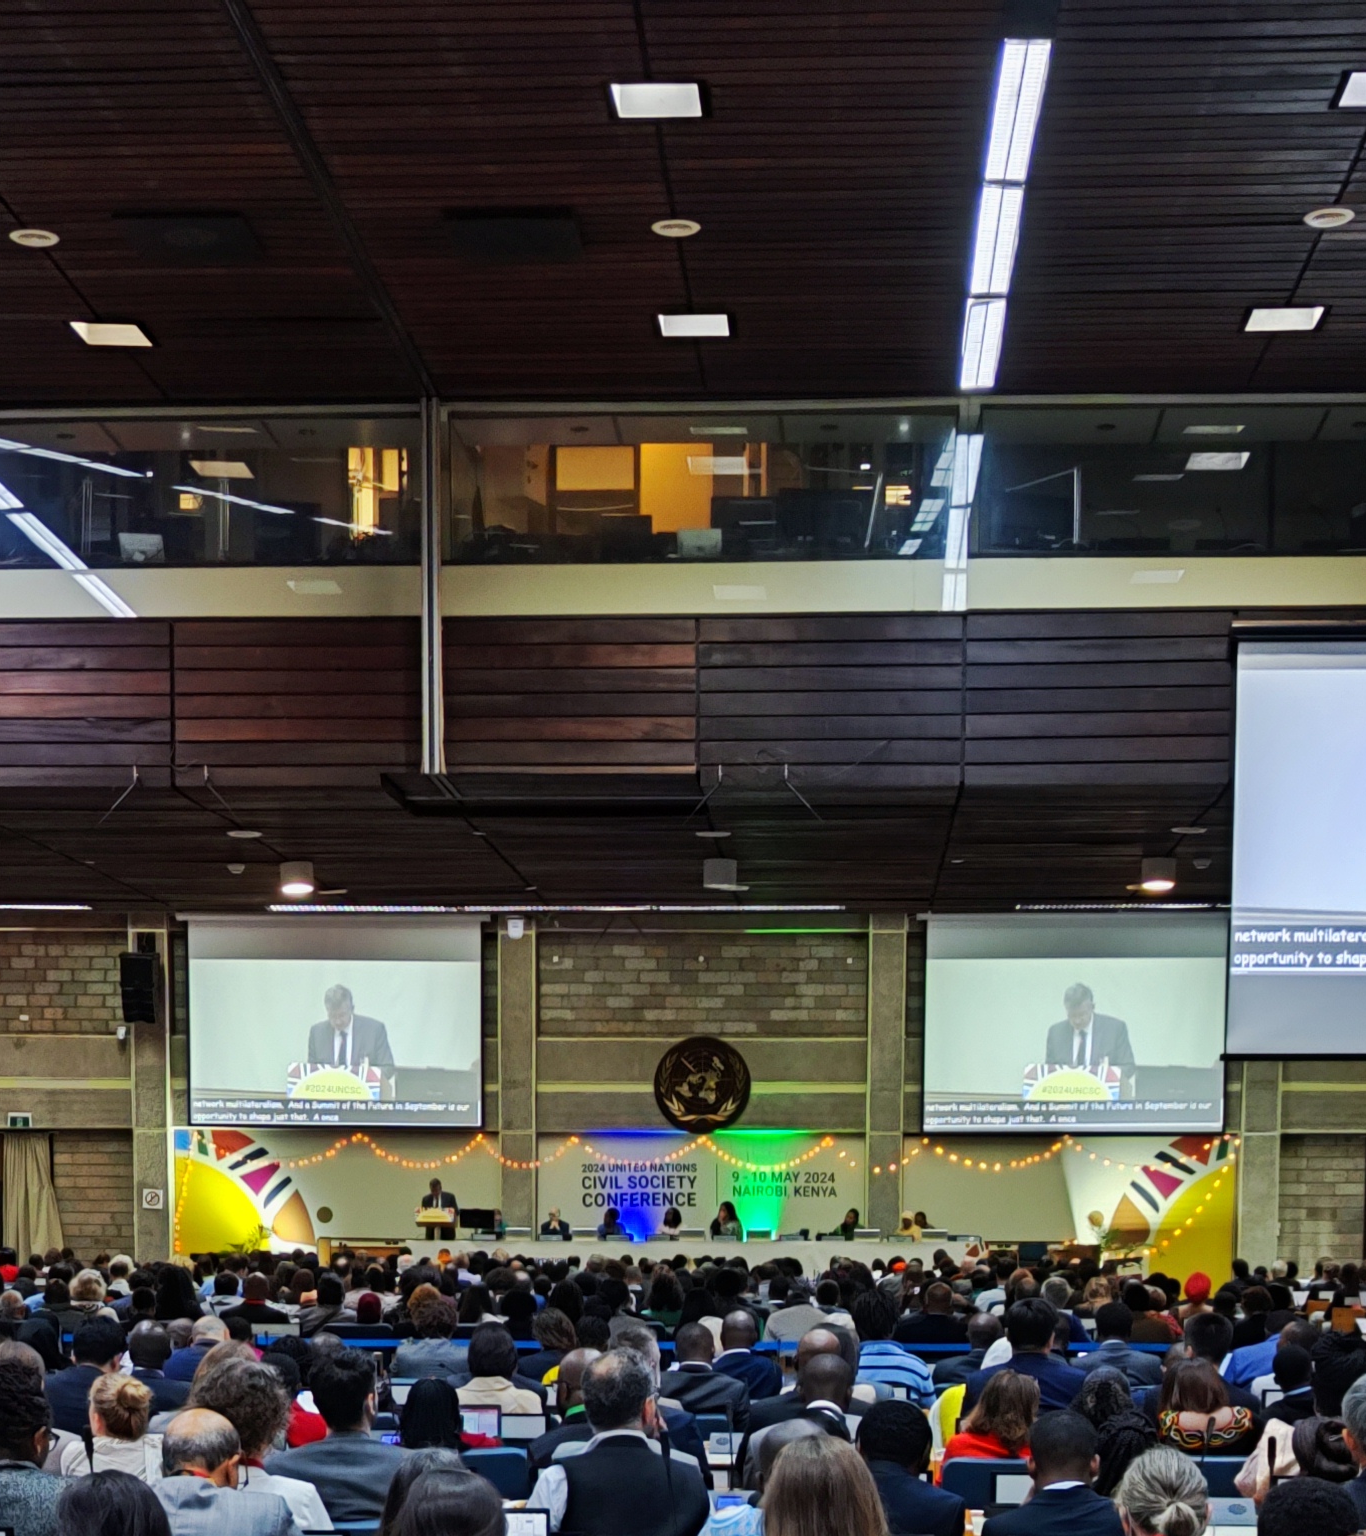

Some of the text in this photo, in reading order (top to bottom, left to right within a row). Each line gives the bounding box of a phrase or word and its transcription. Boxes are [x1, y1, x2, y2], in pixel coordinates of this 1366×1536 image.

[1234, 928, 1291, 943] network
[1234, 951, 1313, 968] opportunity
[1317, 951, 1332, 964] to
[581, 1163, 697, 1173] 2024 UNITED NATIONS
[581, 1175, 697, 1189] CIVIL SOCIETY
[732, 1172, 739, 1183] 9
[752, 1171, 766, 1183] 10
[770, 1171, 800, 1183] MAY
[804, 1172, 835, 1183] 2024
[732, 1185, 837, 1199] NAIROBI, KENYA
[582, 1192, 697, 1208] CONFERENCE
